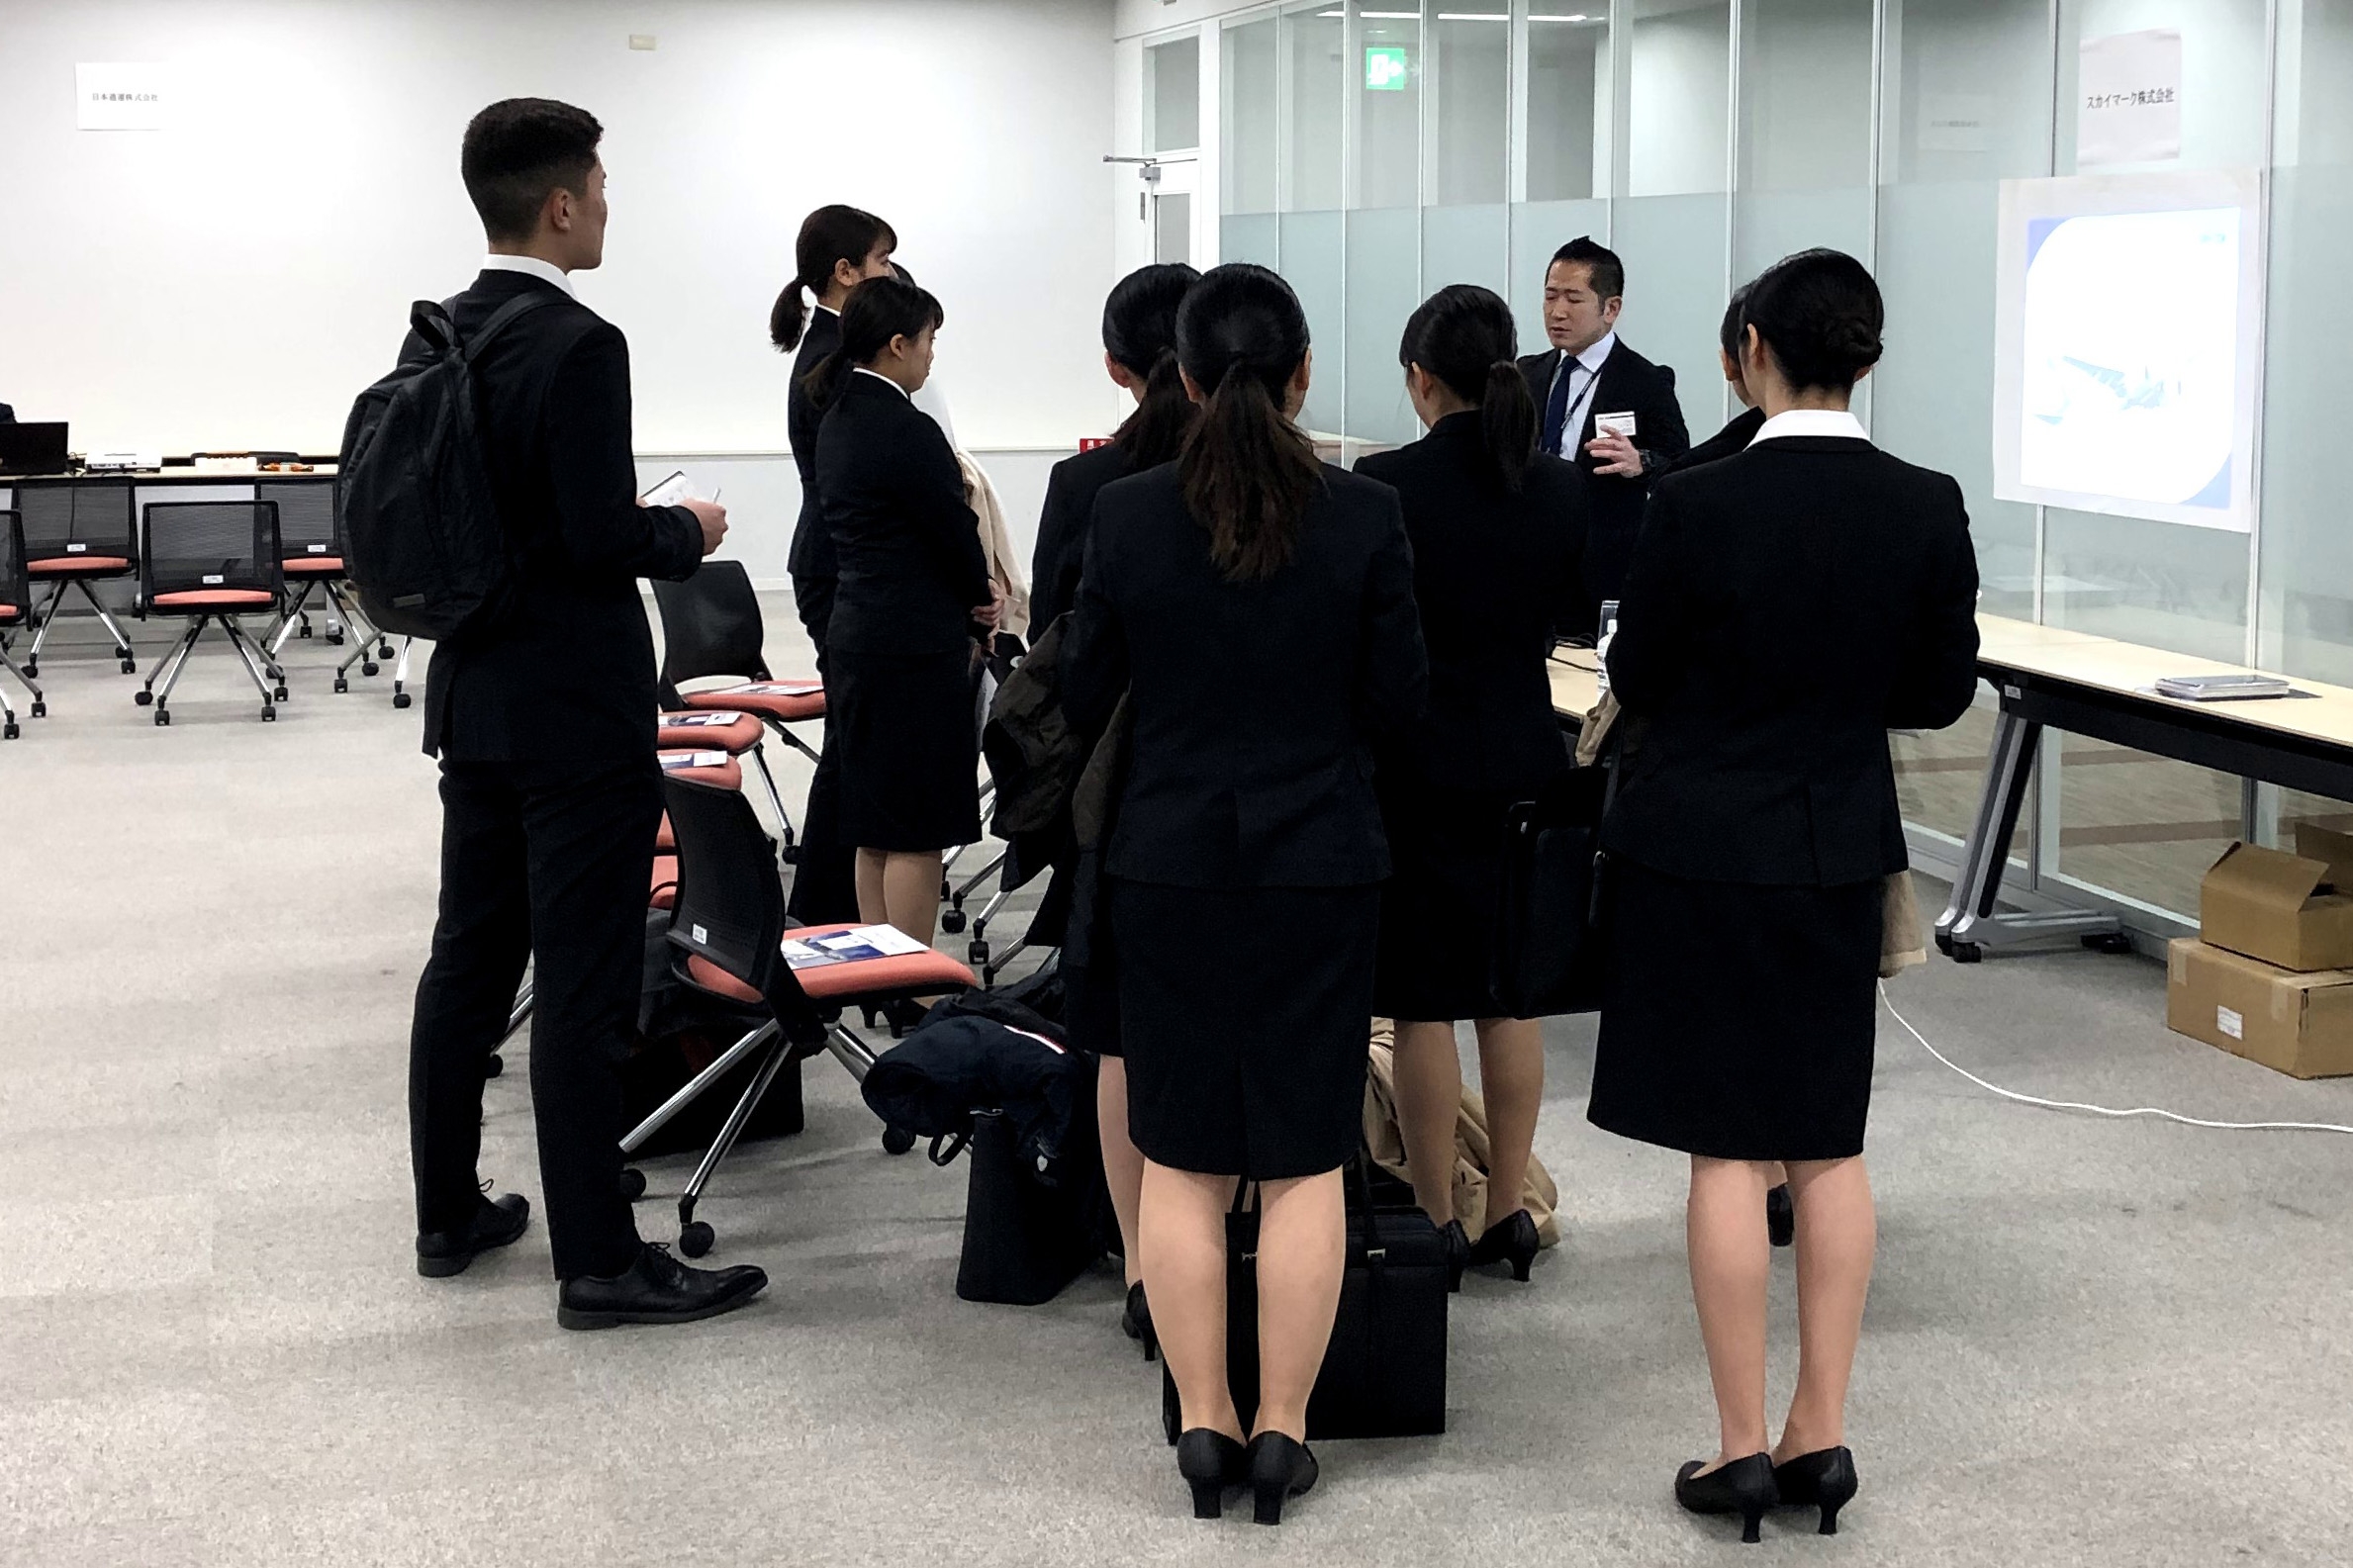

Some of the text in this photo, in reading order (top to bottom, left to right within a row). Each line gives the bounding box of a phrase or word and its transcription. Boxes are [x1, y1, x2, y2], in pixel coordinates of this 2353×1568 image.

[2087, 87, 2175, 110] スカイマーク株式会社
